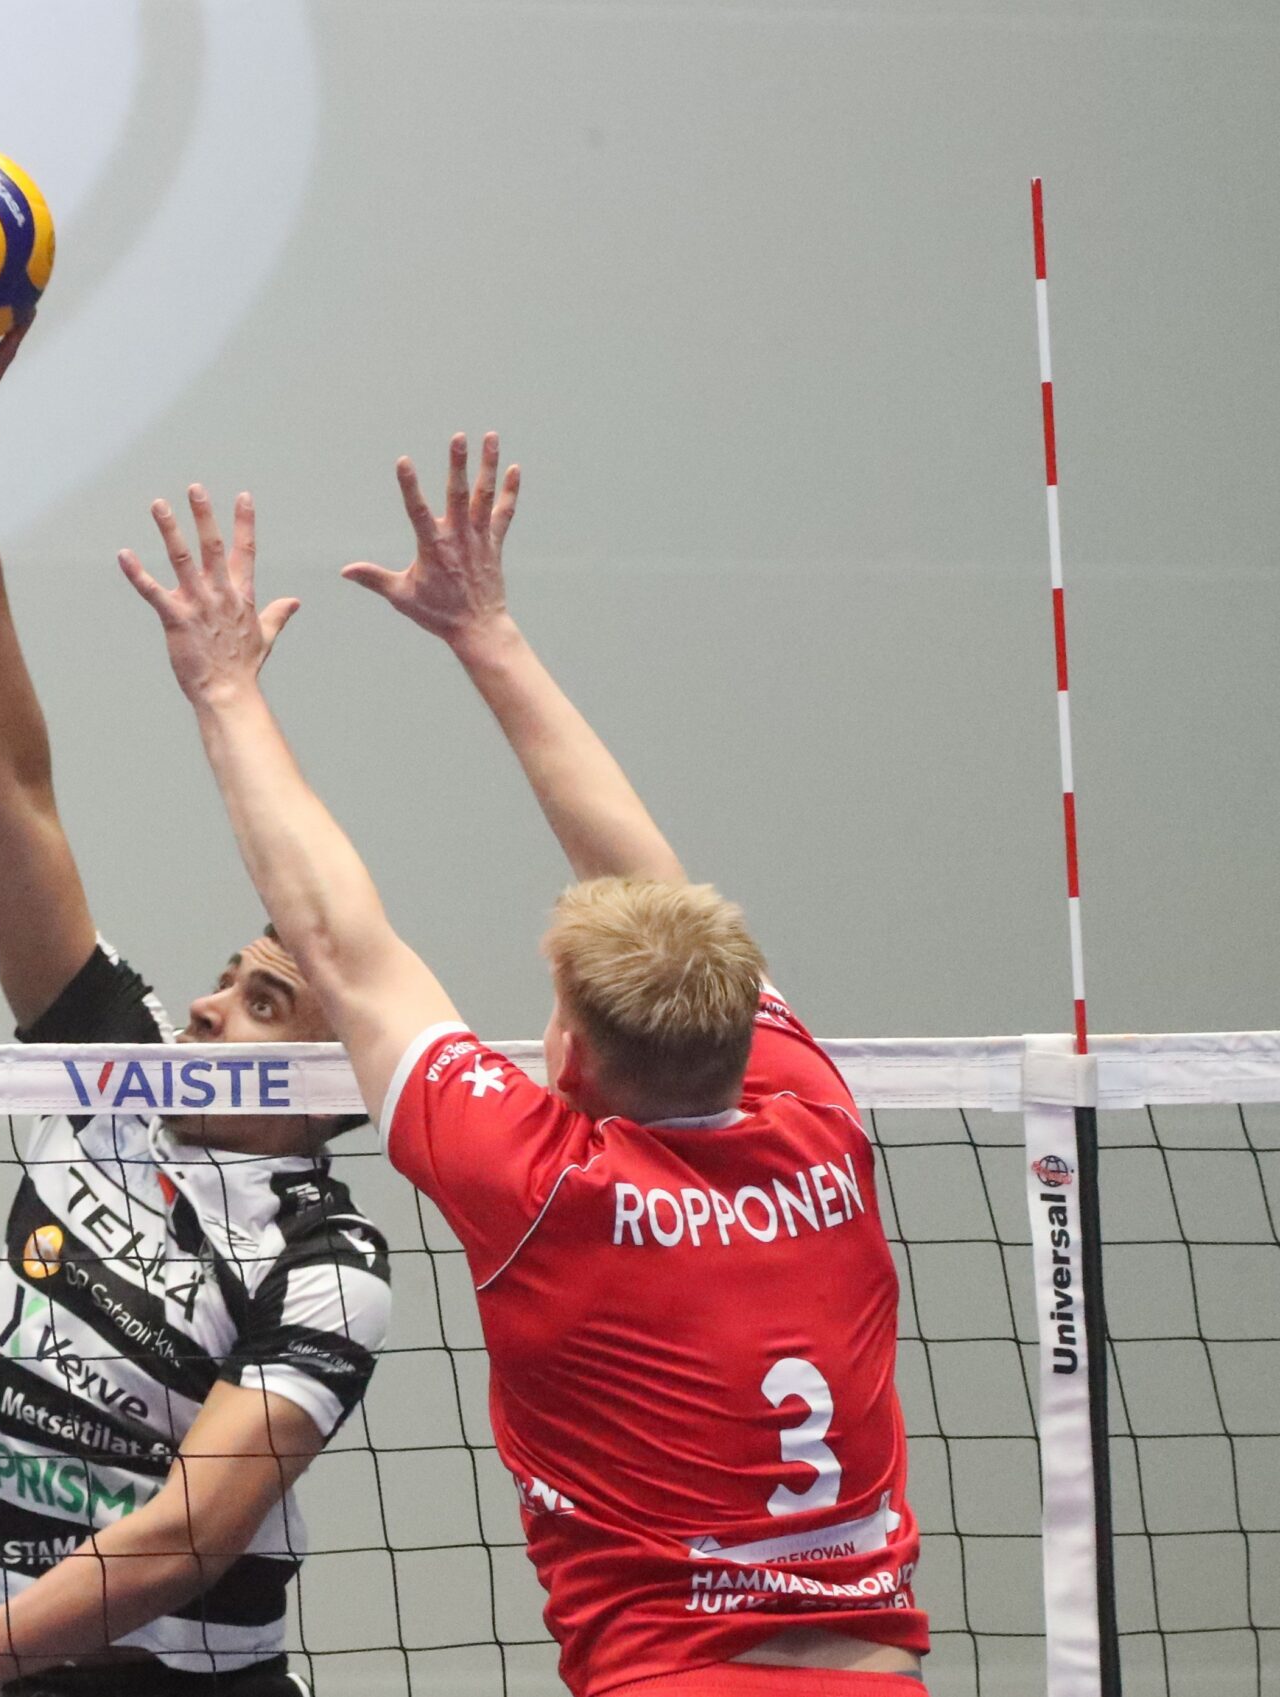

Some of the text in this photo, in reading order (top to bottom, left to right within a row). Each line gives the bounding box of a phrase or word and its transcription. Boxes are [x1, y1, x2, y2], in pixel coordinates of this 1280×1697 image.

[63, 1060, 290, 1108] VAISTE
[613, 1153, 865, 1247] ROPPONEN
[1040, 1193, 1078, 1375] Universal
[36, 1324, 148, 1420] Vexve
[761, 1357, 842, 1517] 3
[765, 1541, 855, 1564] EKOVAN
[685, 1592, 777, 1614] JUKK
